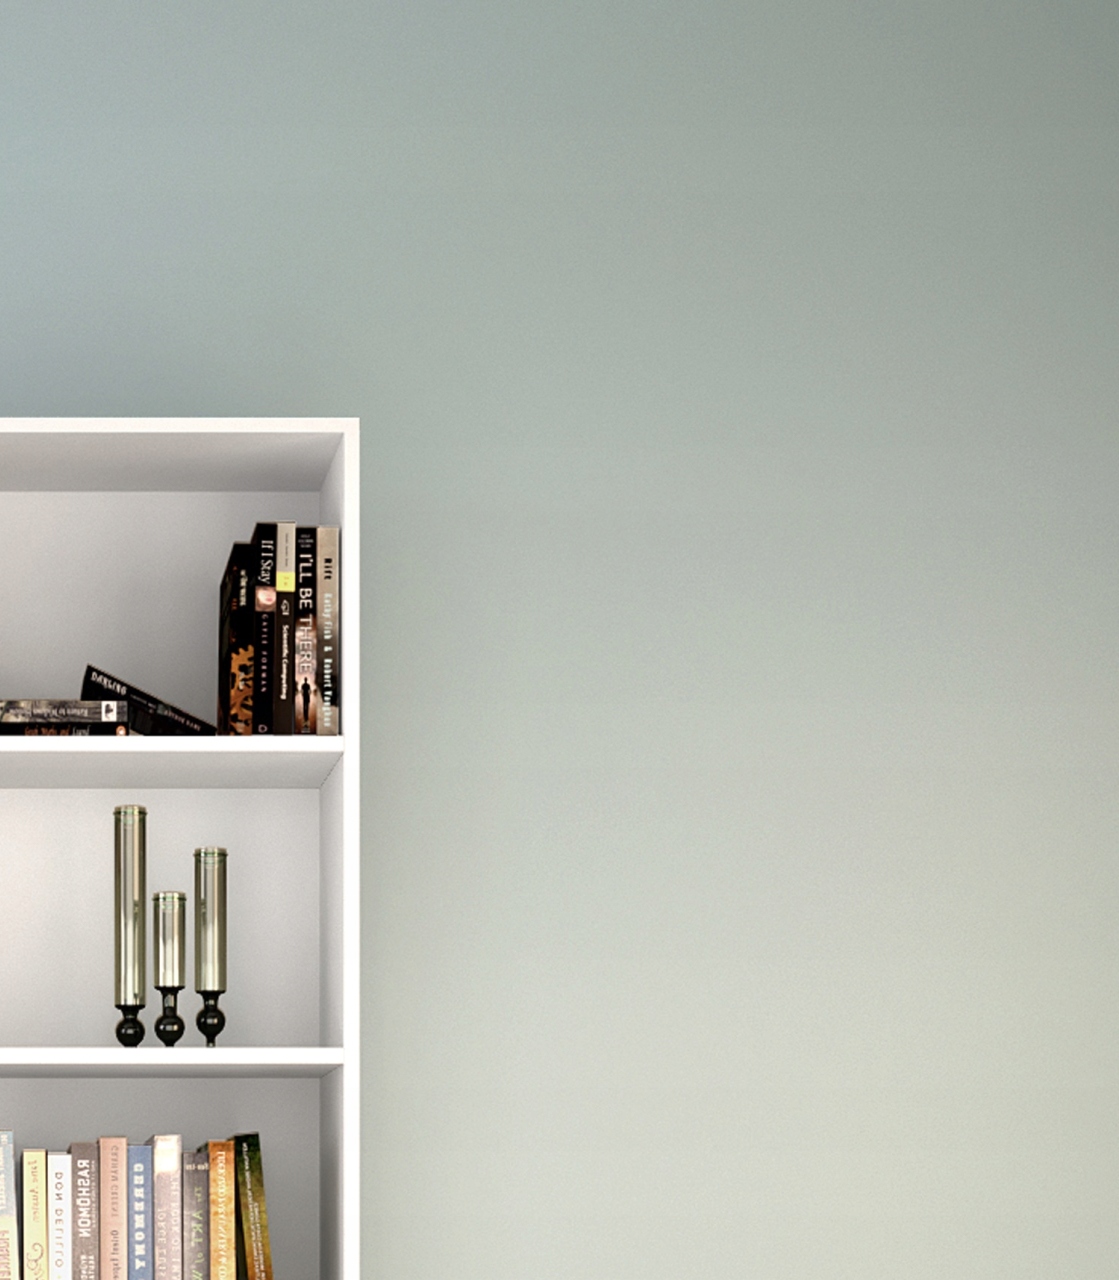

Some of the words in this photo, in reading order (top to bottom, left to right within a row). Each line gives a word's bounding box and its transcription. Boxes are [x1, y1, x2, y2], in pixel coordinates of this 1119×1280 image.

[261, 540, 273, 551] If
[258, 559, 274, 585] Stay
[324, 558, 332, 580] Rift
[299, 588, 312, 609] BE
[281, 625, 289, 658] Scientific
[299, 614, 313, 673] THERE
[324, 621, 332, 640] Fish
[279, 659, 288, 700] Computing
[324, 658, 332, 688] Robert
